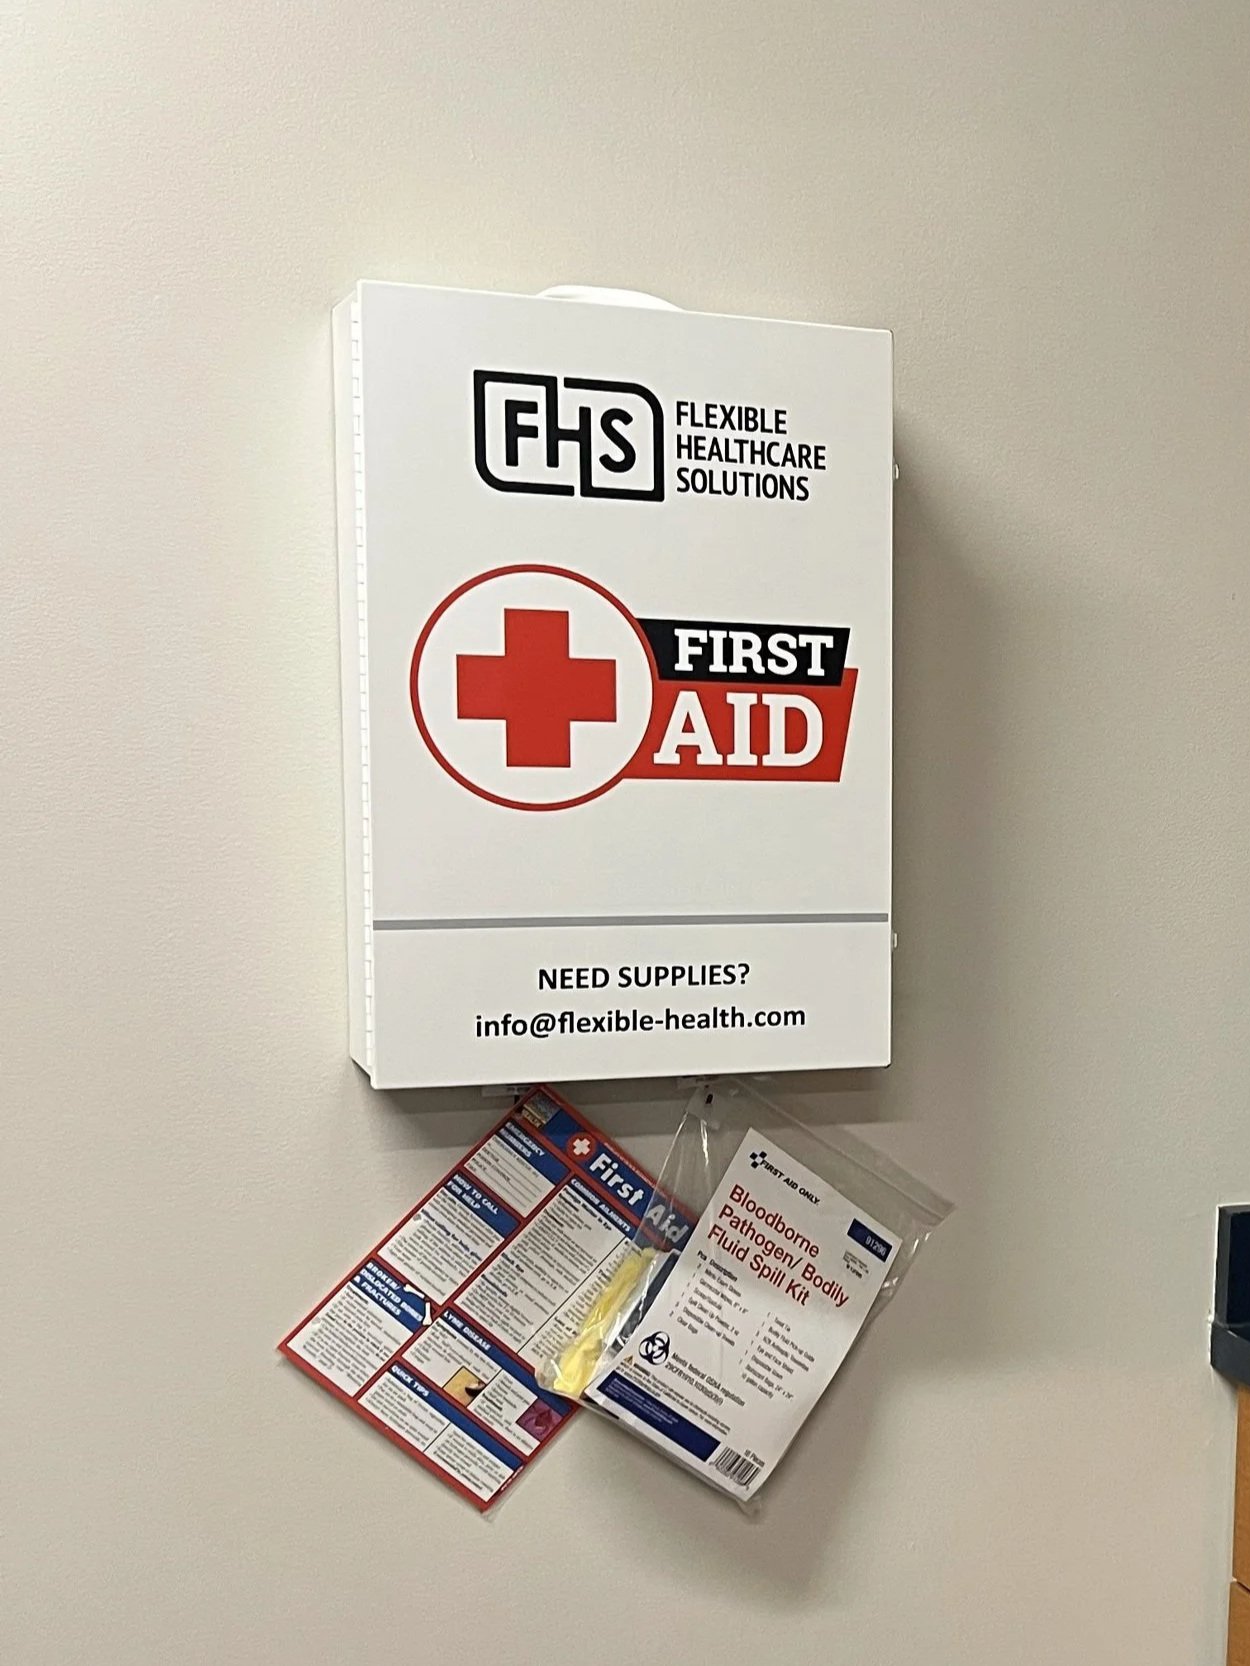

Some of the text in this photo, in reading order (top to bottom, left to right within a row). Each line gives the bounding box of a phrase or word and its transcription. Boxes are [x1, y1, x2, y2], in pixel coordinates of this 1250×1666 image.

[504, 397, 637, 473] FHS
[676, 401, 788, 435] FLEXIBLE
[676, 435, 827, 471] HEALTHCARE
[676, 467, 810, 501] SOLUTIONS
[673, 628, 834, 677] FIRST
[653, 690, 824, 768] AID
[537, 963, 751, 990] NEED SUPPLIES?
[475, 1006, 806, 1039] info@flexible-health.com
[505, 1122, 545, 1156] EMERGENCY
[759, 1158, 785, 1179] FIRST
[783, 1177, 799, 1190] AID
[446, 1180, 481, 1209] FOR HELP
[453, 1174, 498, 1215] HOW TO CALL
[570, 1178, 600, 1205] COMMON
[598, 1204, 631, 1232] AILMENTS
[589, 1153, 644, 1206] First
[645, 1205, 690, 1243] Aid
[729, 1183, 819, 1258] Bloodborne
[707, 1223, 810, 1306] Fluid Spill Kit
[718, 1203, 803, 1270] Pathogen/
[800, 1262, 849, 1308] Bodily
[359, 1268, 423, 1322] DISLOCATED BONES
[366, 1262, 400, 1290] BROKEN/
[361, 1281, 401, 1315] FRACTURES
[443, 1310, 491, 1350] LYME DISEASE
[391, 1365, 429, 1397] QUICK TIPS
